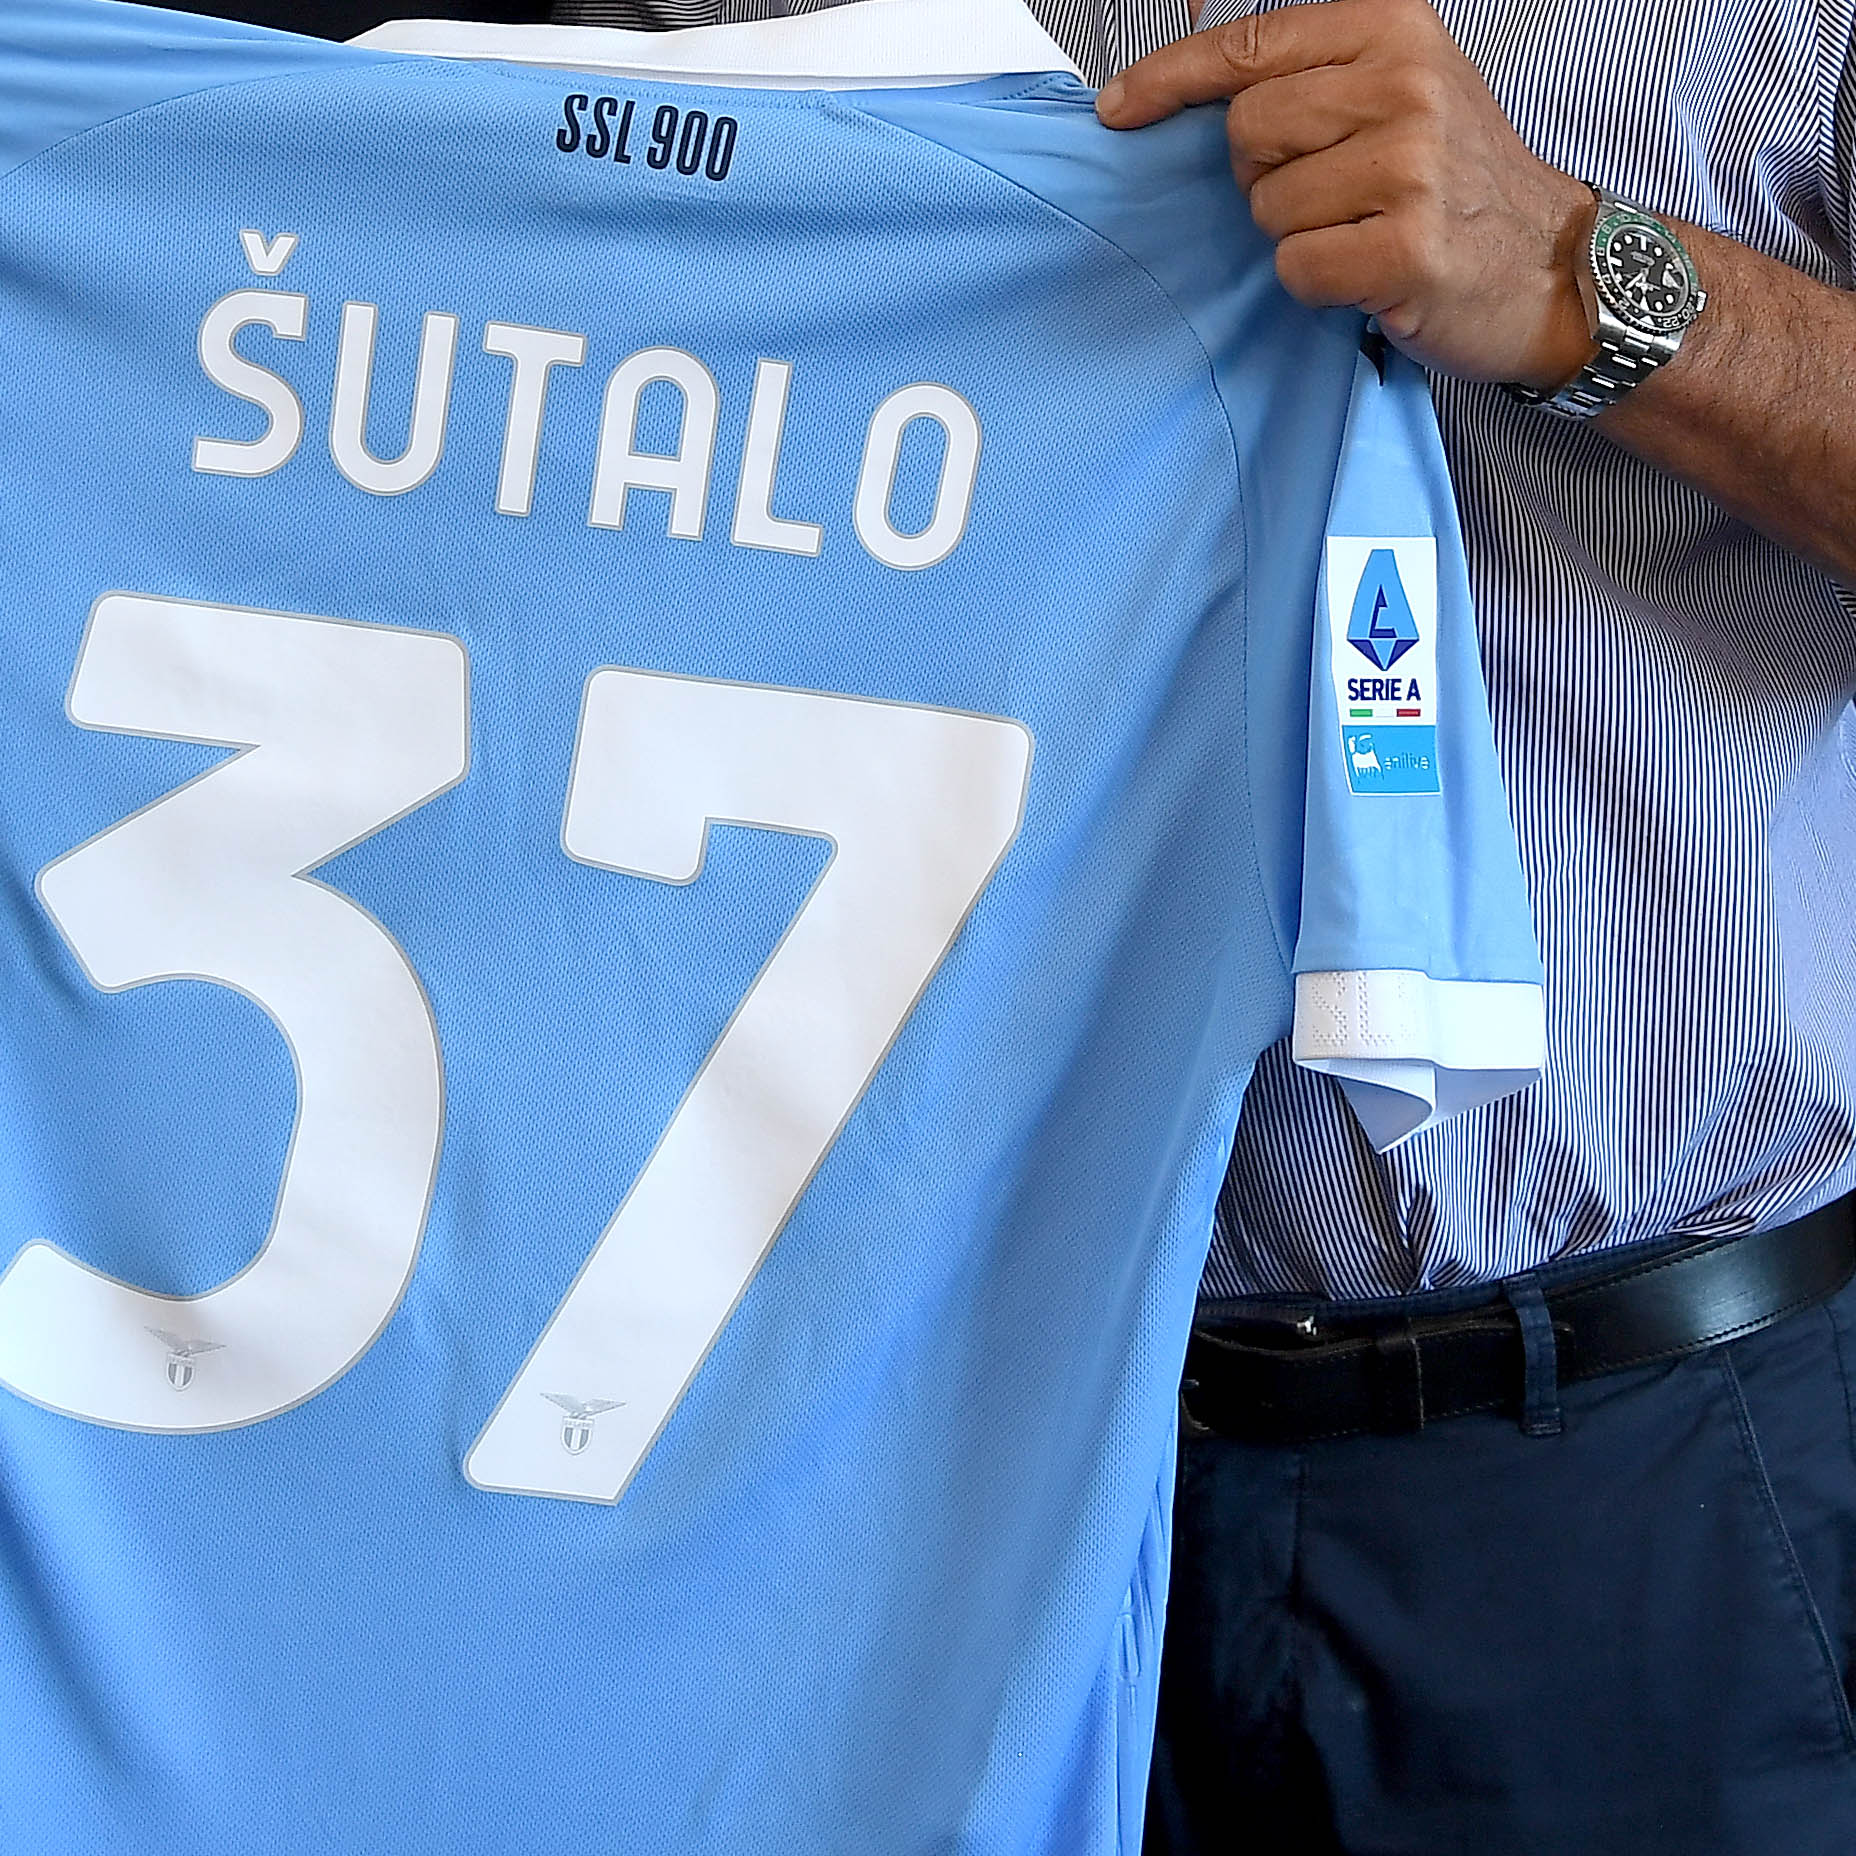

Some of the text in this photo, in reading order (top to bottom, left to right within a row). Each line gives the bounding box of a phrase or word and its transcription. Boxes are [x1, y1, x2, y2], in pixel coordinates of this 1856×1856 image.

[555, 93, 739, 182] SSL 900
[192, 228, 983, 572] ŠUTALO
[1347, 678, 1421, 701] SERIE A
